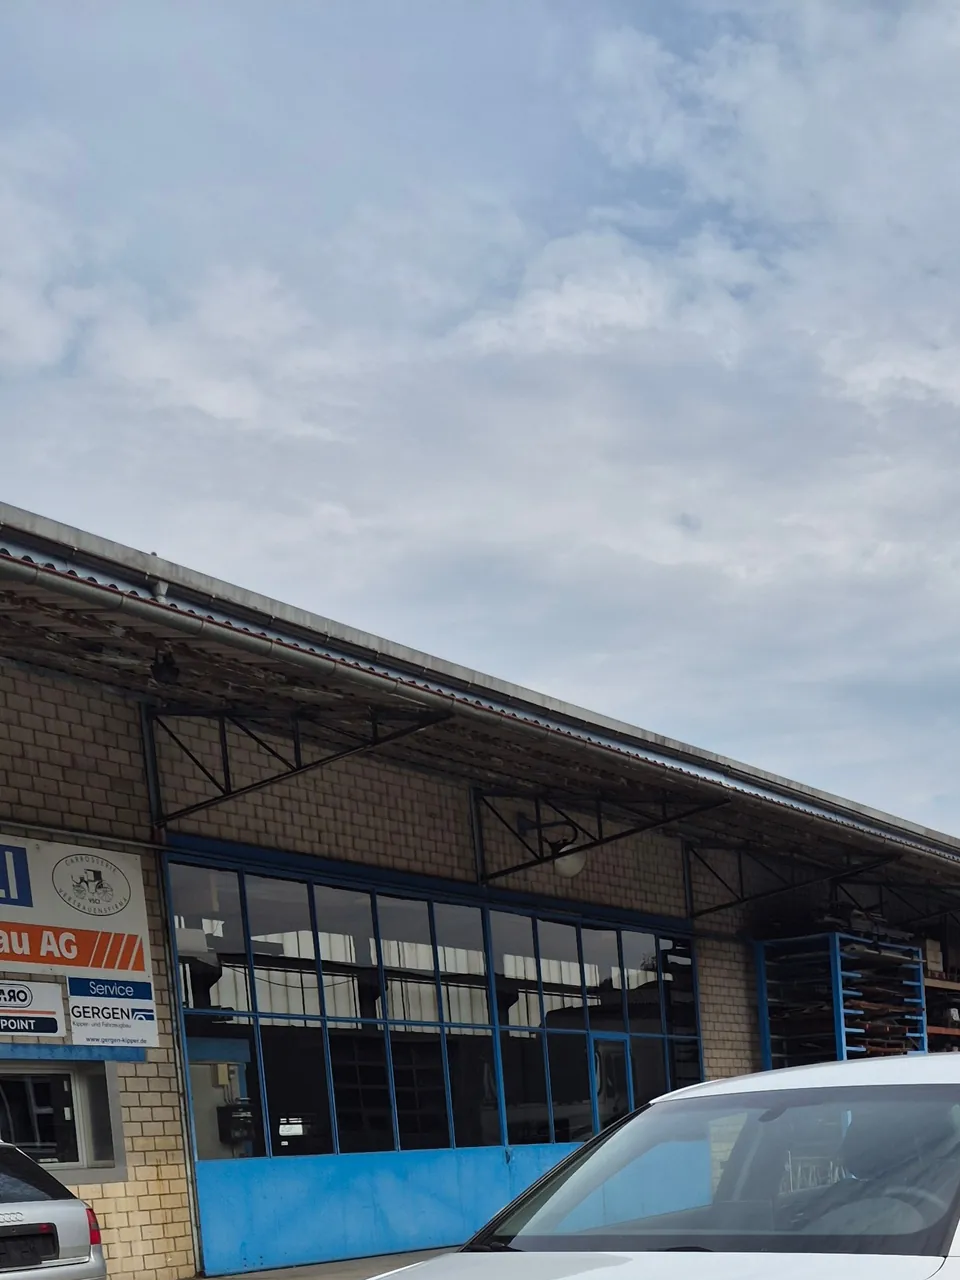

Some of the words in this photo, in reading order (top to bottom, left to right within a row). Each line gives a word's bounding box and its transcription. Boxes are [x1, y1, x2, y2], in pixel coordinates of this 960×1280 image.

[40, 930, 78, 960] AG
[89, 981, 134, 997] Service
[71, 1005, 130, 1020] GERGEN
[0, 1019, 36, 1030] POINT
